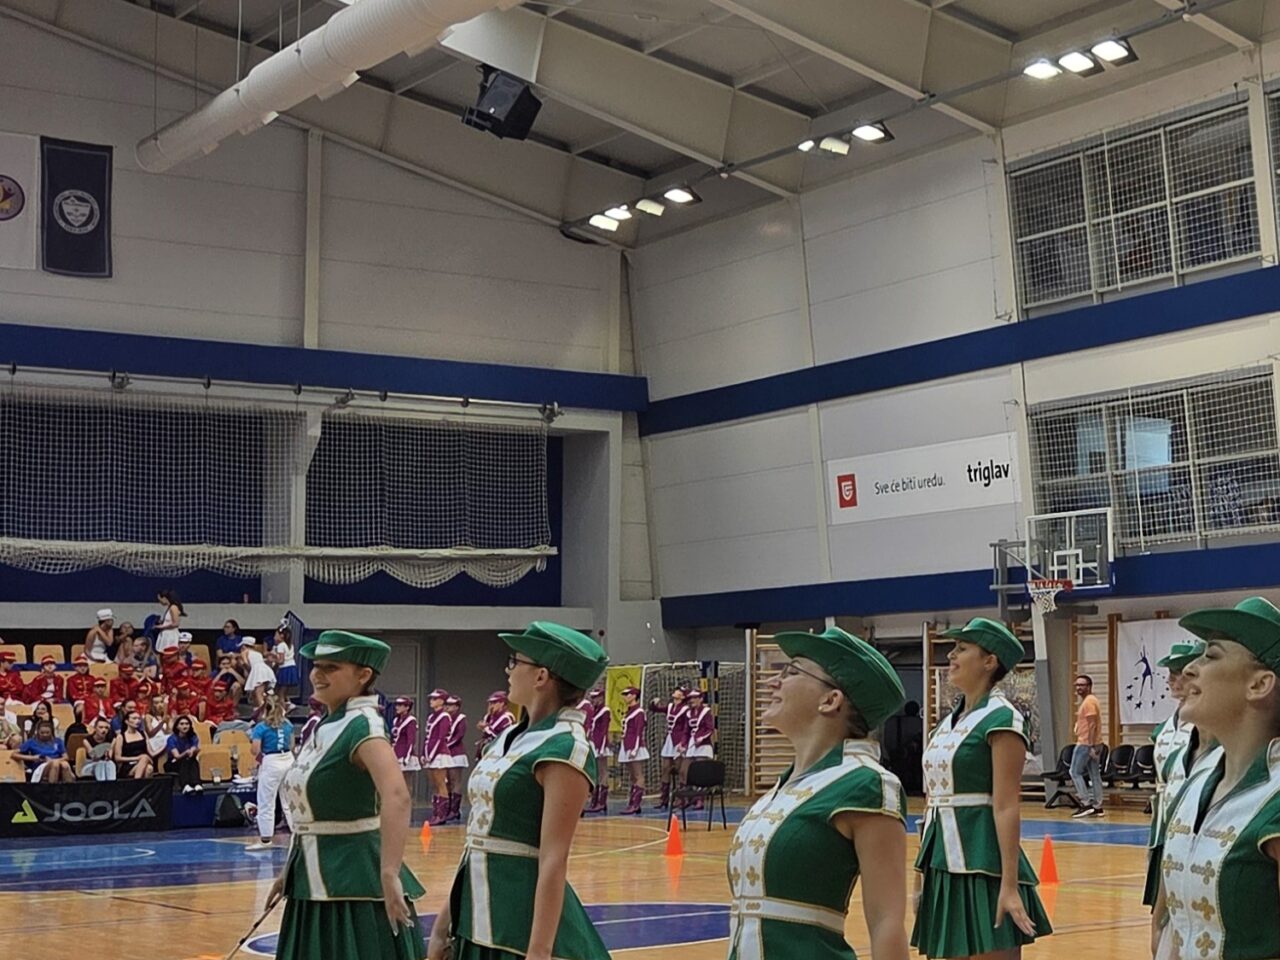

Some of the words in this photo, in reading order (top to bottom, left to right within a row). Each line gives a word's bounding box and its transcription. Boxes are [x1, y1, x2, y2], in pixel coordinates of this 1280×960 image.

[966, 459, 1010, 487] triglav
[874, 481, 889, 495] Sve
[902, 476, 917, 491] biti
[43, 798, 157, 822] JOOLA
